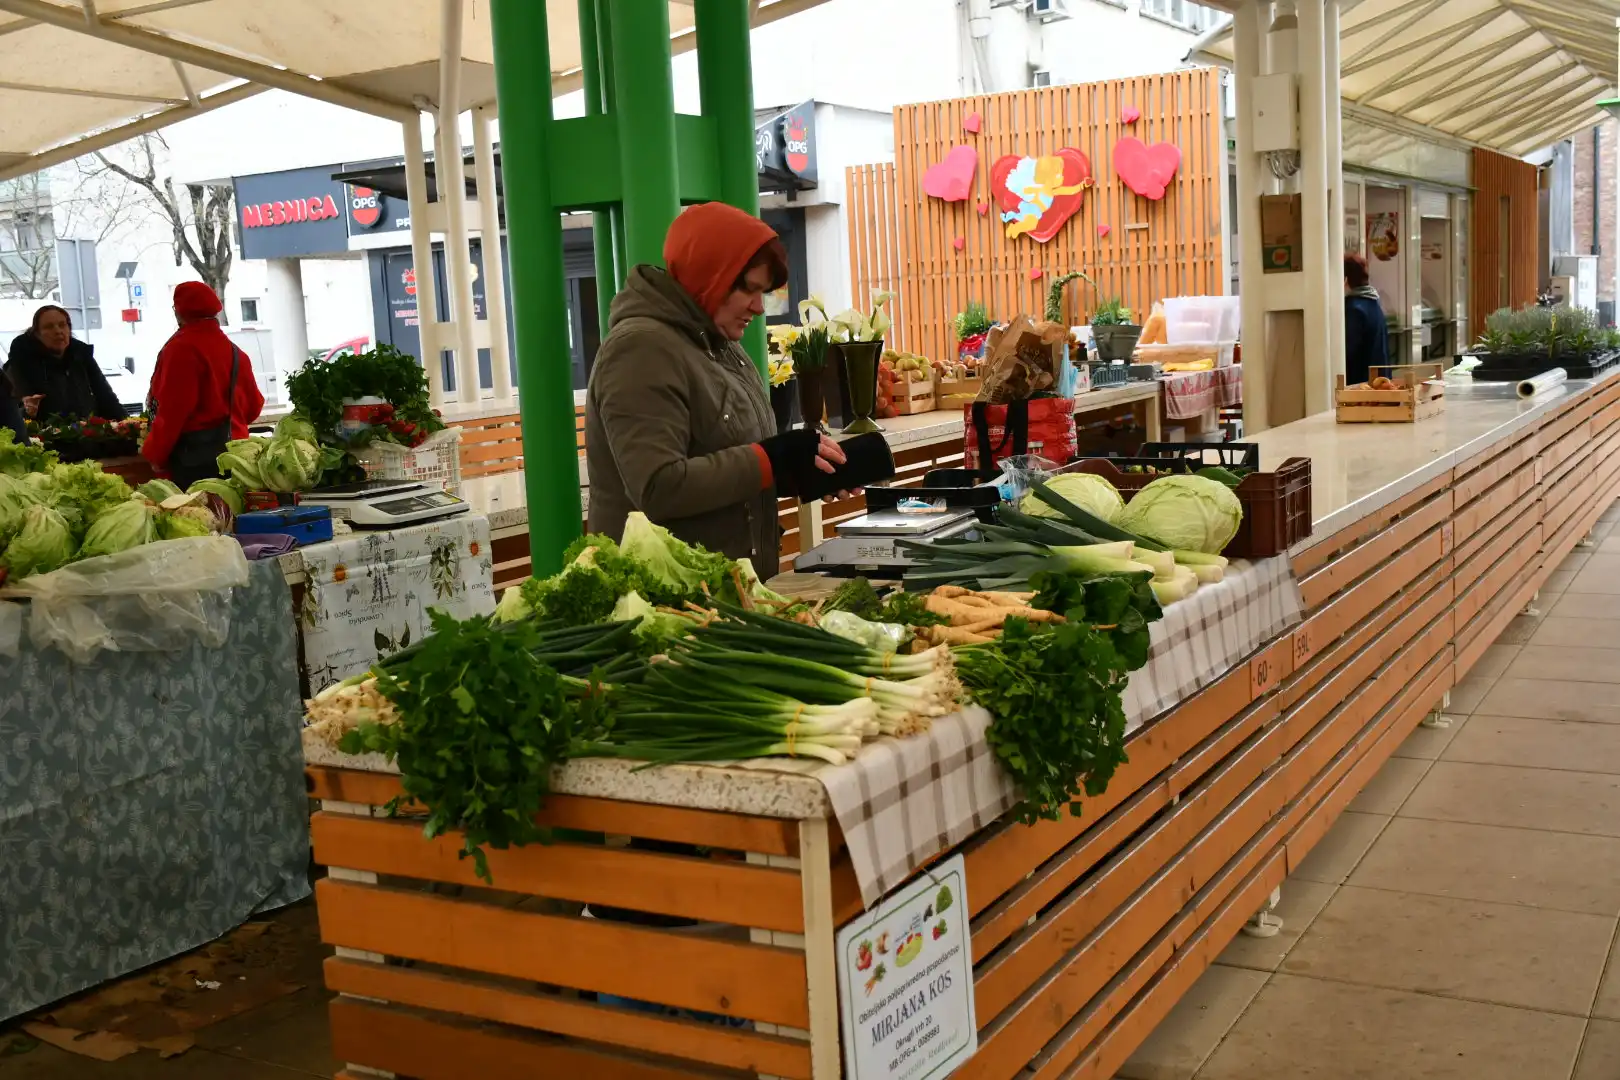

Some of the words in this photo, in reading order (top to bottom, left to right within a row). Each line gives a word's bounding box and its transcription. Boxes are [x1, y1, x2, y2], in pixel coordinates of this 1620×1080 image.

[788, 140, 808, 154] OPG
[242, 194, 340, 229] MESNICA
[352, 197, 377, 210] OPG
[871, 990, 927, 1048] MIRJANA
[928, 970, 953, 1002] KOS
